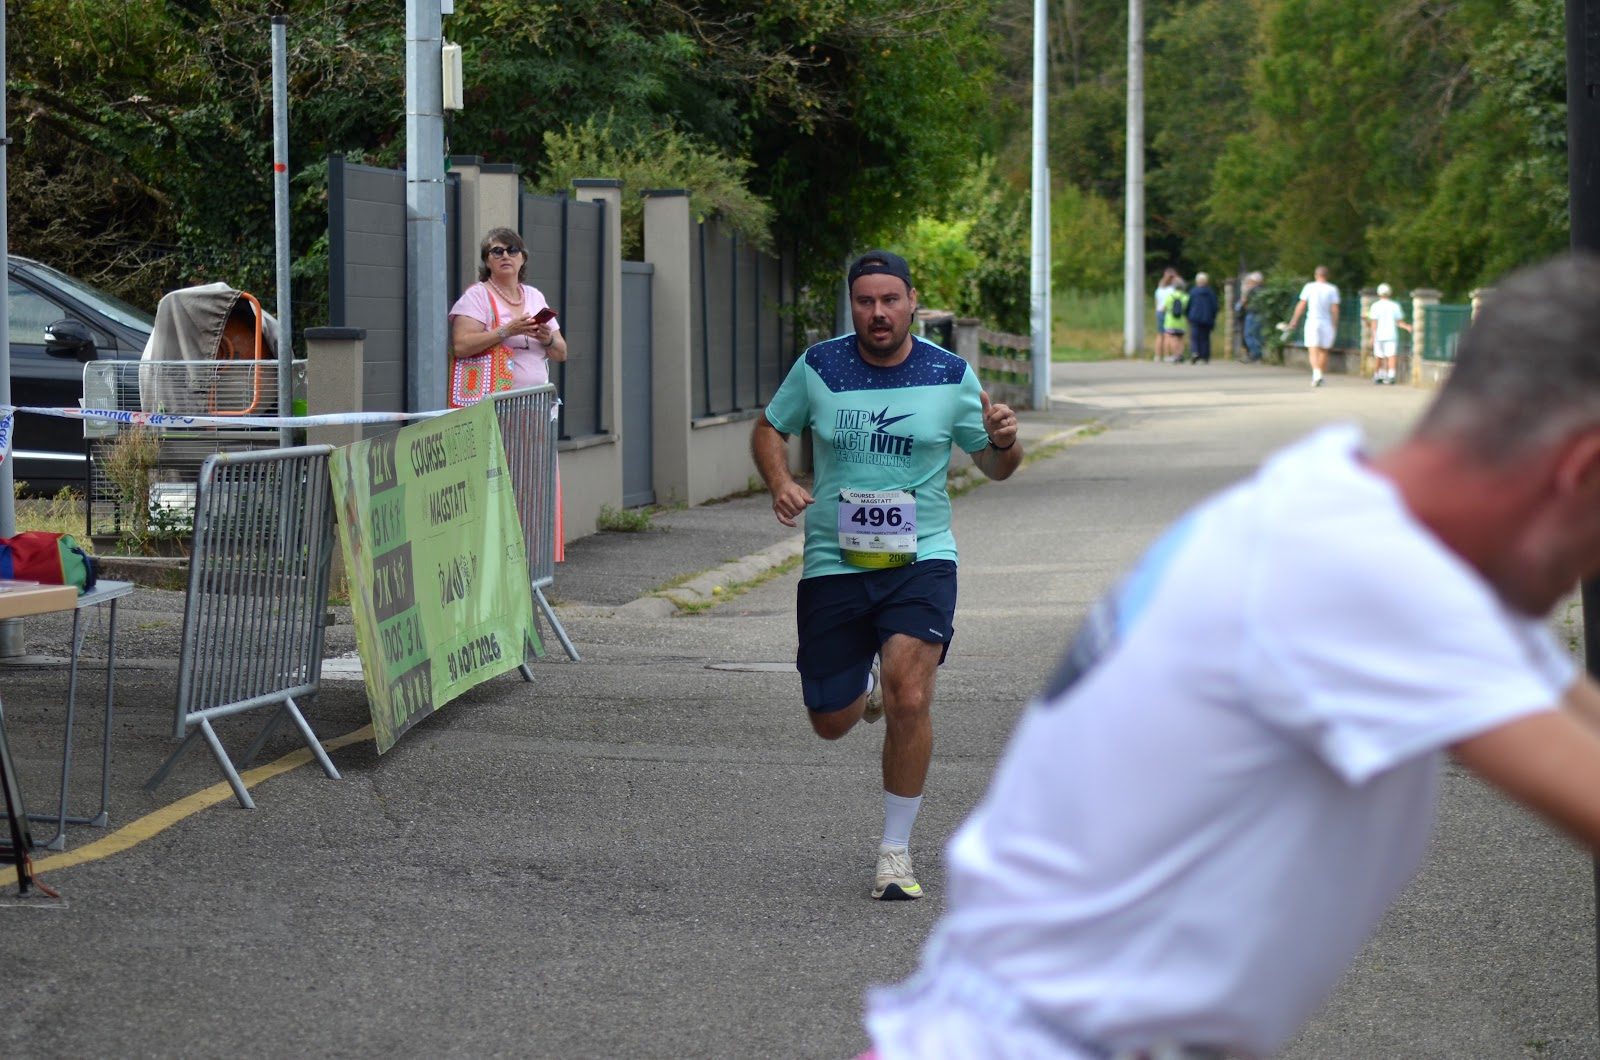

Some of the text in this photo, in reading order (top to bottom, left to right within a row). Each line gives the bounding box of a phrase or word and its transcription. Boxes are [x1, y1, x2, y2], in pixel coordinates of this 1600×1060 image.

[835, 409, 870, 430] IMP
[410, 431, 447, 478] COURSES
[835, 449, 911, 469] TEAM RUNNING
[429, 480, 468, 527] MAGSTATT
[851, 506, 903, 527] 496
[475, 632, 502, 667] 2026
